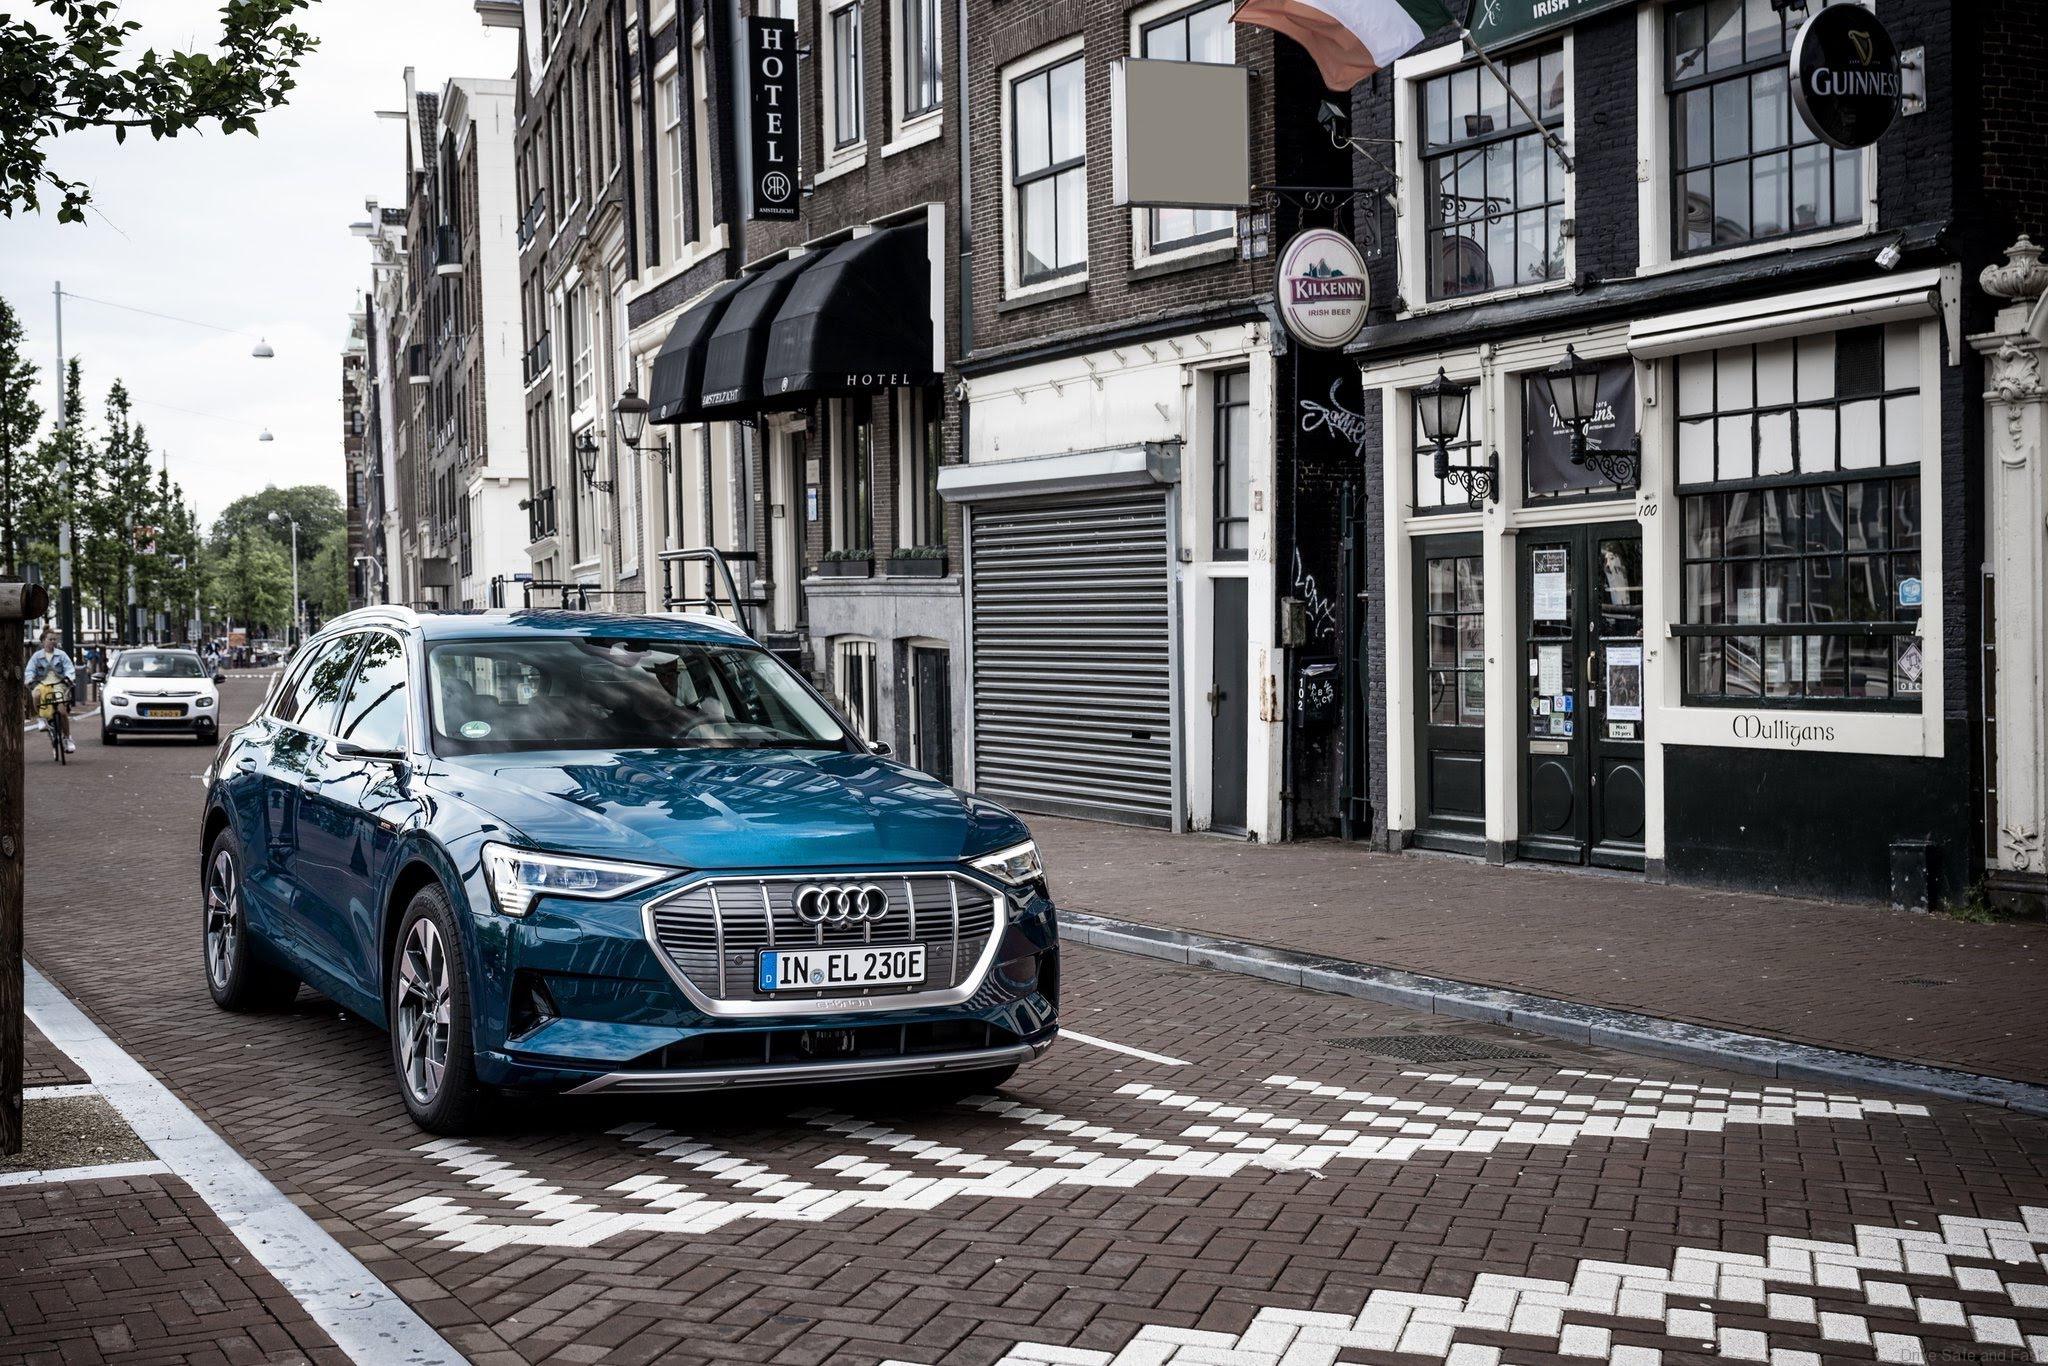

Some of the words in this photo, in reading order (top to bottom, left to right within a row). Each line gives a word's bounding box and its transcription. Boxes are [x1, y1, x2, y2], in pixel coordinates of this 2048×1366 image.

[1533, 0, 1569, 18] IRISH
[1811, 67, 1899, 97] GUINNESS
[761, 28, 784, 162] HOTEL
[1295, 280, 1362, 298] KILKENNY
[1331, 308, 1351, 316] BEER
[847, 373, 909, 386] HOTEL
[1638, 504, 1658, 517] 100
[1732, 715, 1835, 747] Mulligans
[780, 956, 808, 984] IN
[828, 954, 857, 983] EL
[864, 951, 922, 980] 230E
[765, 974, 773, 983] D
